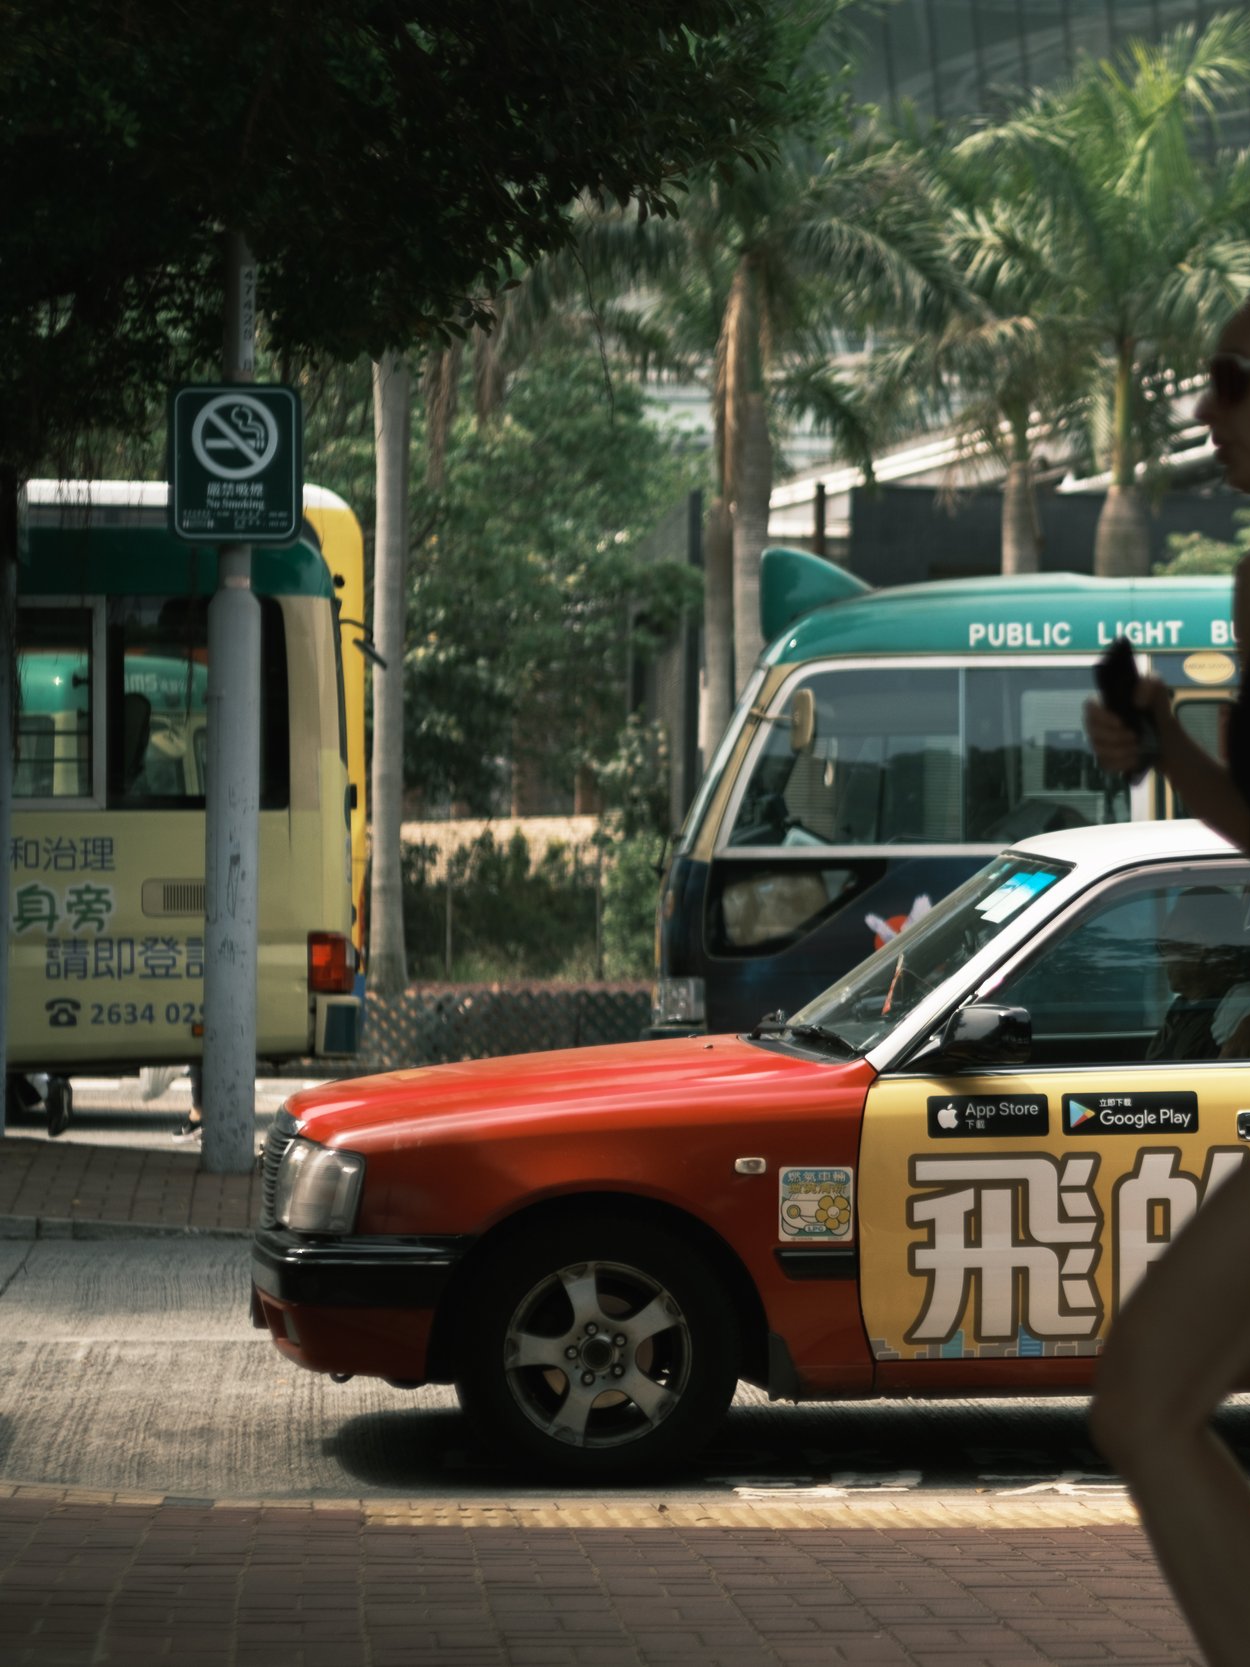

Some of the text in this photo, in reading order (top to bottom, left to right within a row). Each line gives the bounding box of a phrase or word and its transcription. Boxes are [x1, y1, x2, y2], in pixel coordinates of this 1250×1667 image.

[207, 499, 265, 511] No Smoking
[969, 621, 1071, 646] PUBLIC
[1097, 619, 1183, 645] LIGHT
[12, 883, 112, 932] 身旁
[90, 1003, 155, 1025] 2634
[965, 1102, 1039, 1117] App Store
[1100, 1098, 1132, 1107] 立即下載
[1100, 1109, 1192, 1128] Google Play
